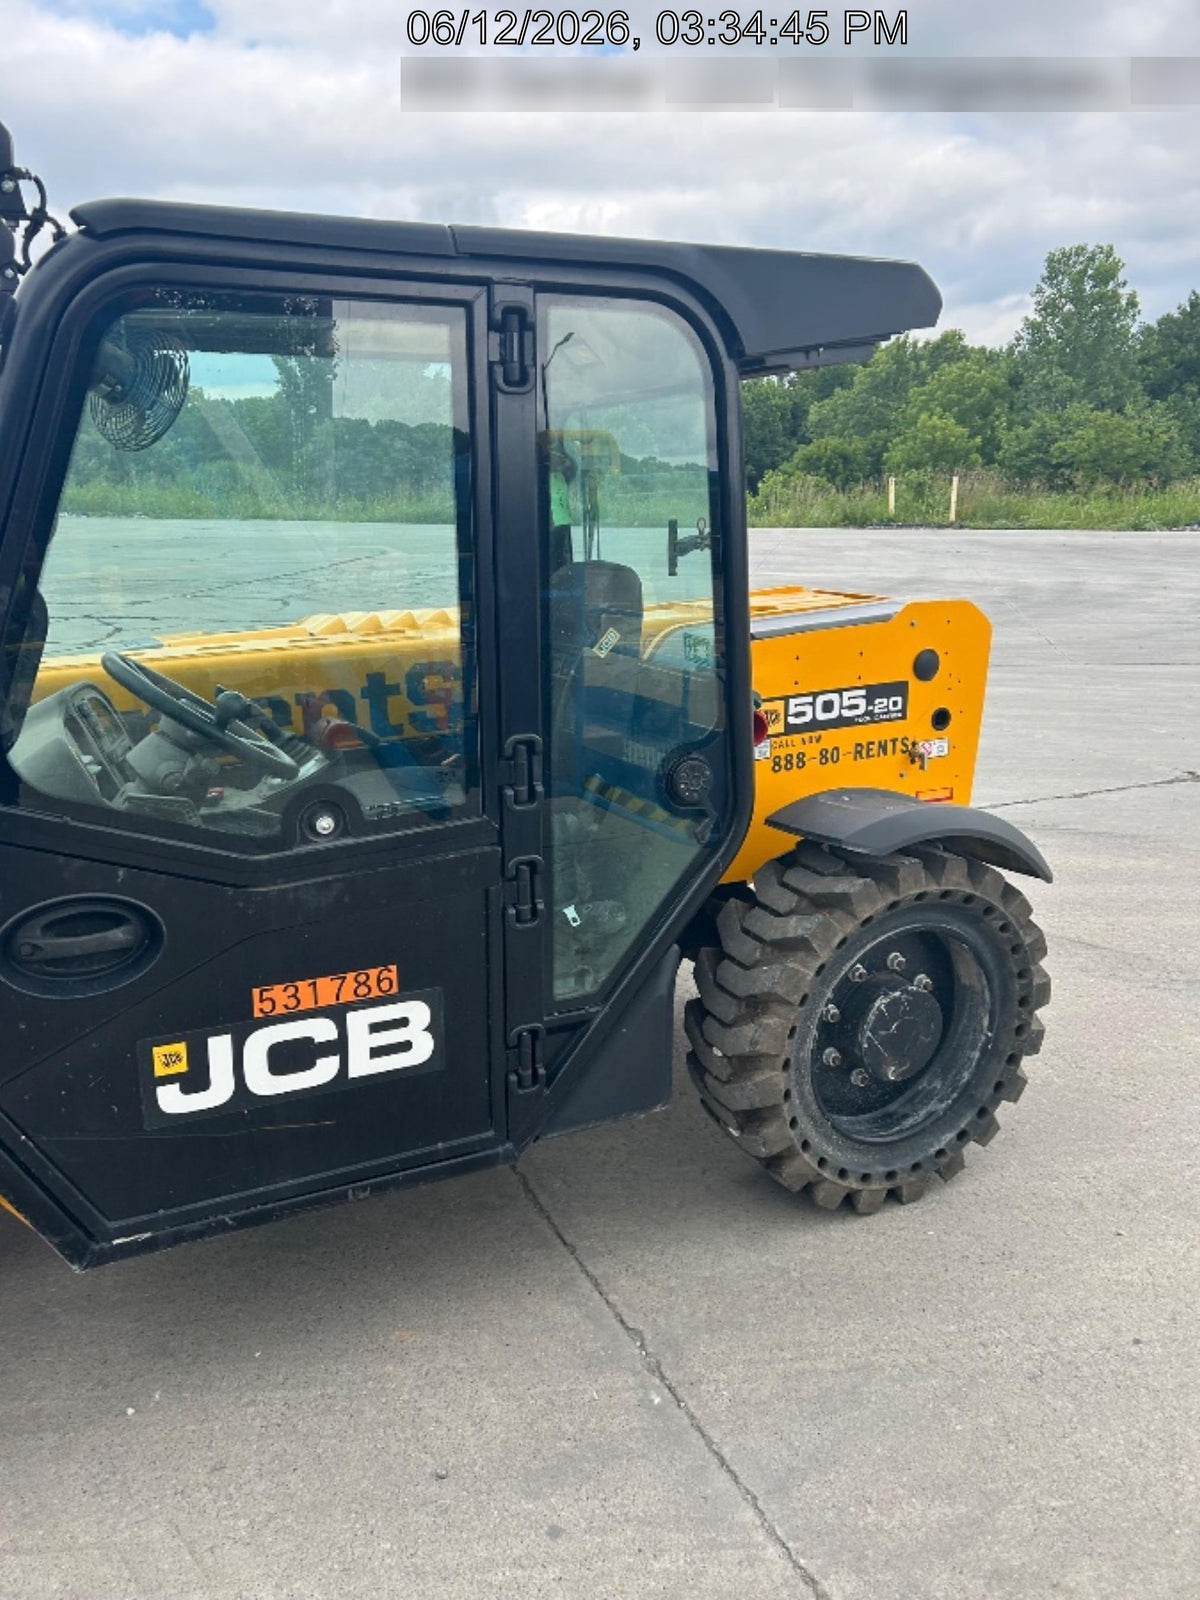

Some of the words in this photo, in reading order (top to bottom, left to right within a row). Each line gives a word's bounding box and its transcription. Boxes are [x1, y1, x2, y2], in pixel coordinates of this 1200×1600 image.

[787, 689, 903, 724] 505-20
[258, 967, 395, 1016] 531786
[155, 1000, 435, 1114] JCB
